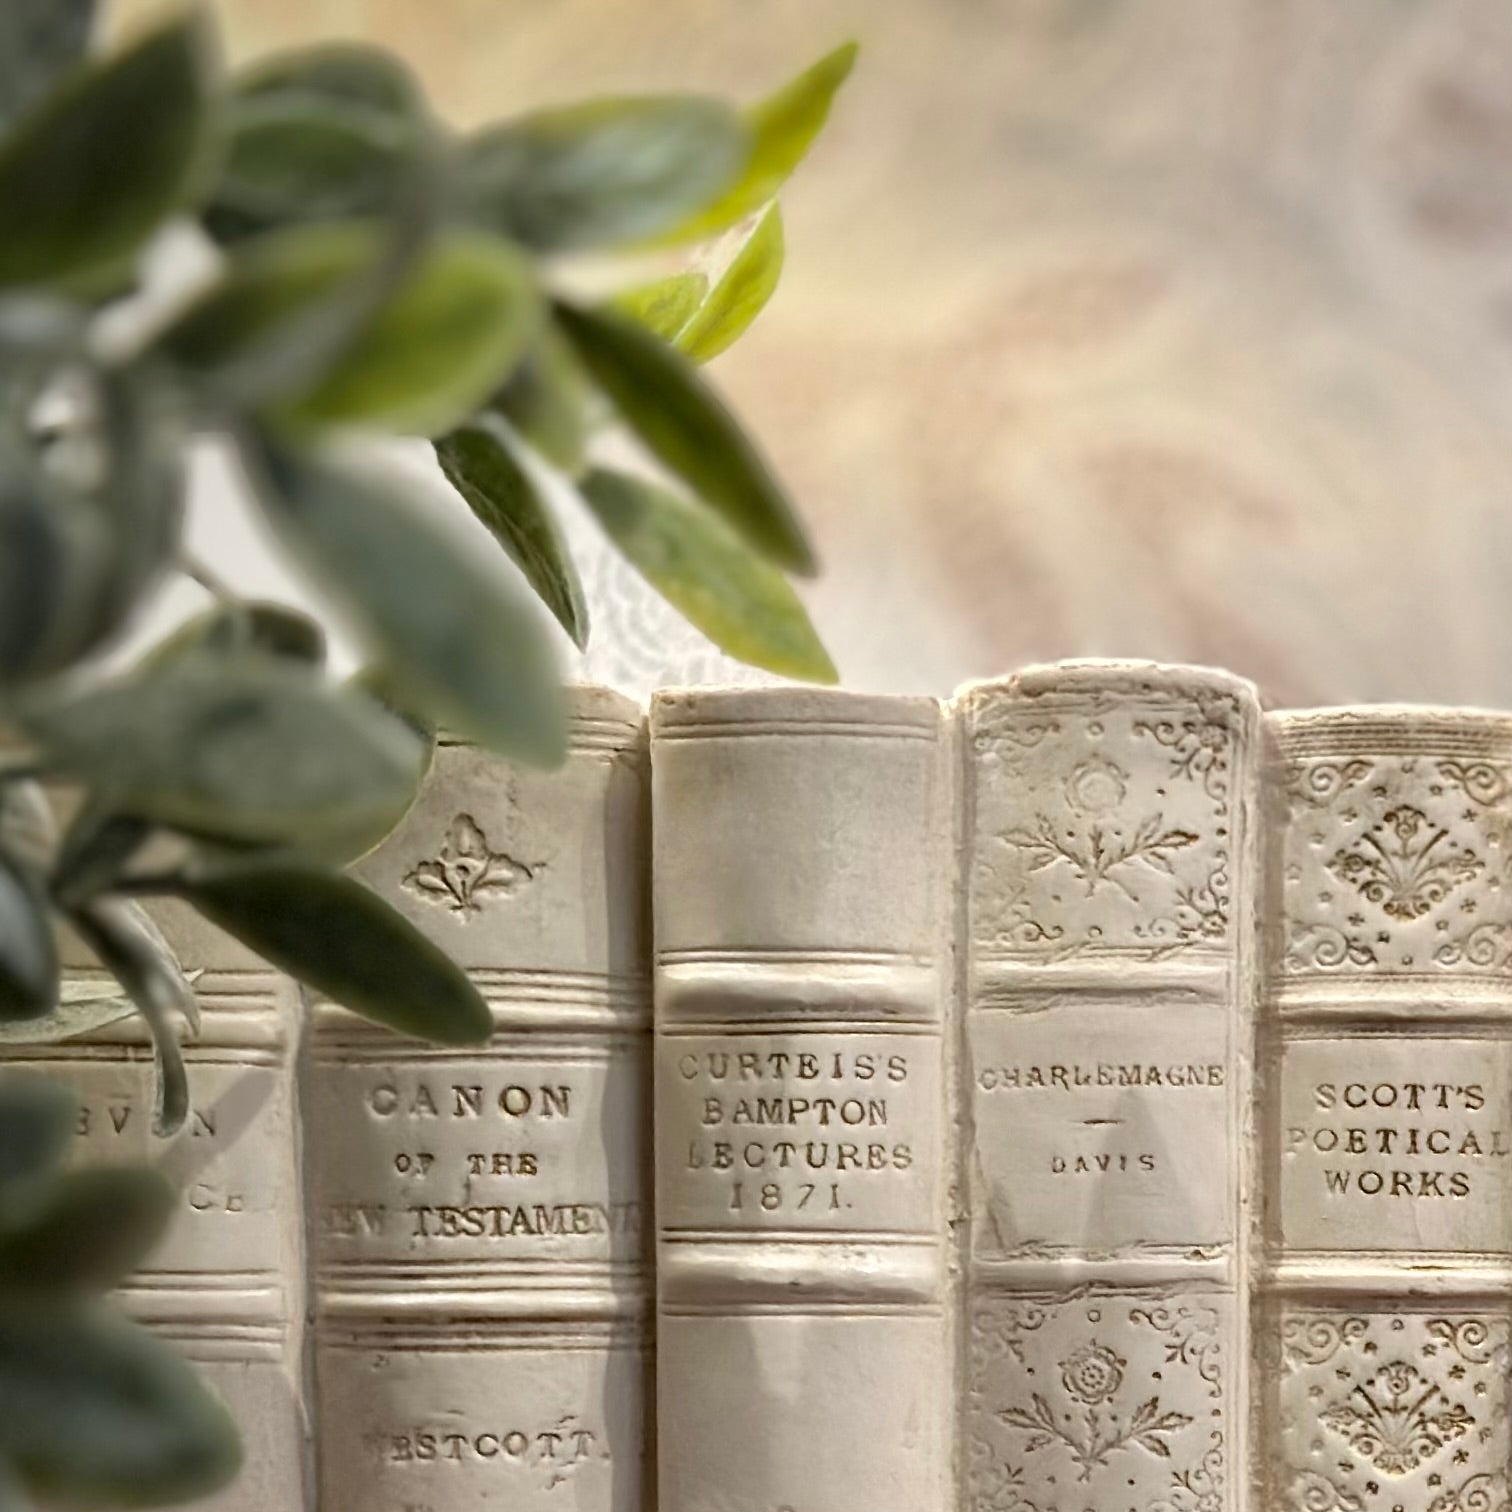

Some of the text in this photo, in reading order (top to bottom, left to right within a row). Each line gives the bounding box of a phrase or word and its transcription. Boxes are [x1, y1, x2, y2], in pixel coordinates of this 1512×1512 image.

[679, 1053, 908, 1081] CURTEIS'S
[978, 1065, 1224, 1090] CHARLEMAGNE
[370, 1085, 573, 1117] CANON
[1314, 1083, 1485, 1110] SCOTT'S
[702, 1098, 889, 1126] BAMPTON
[687, 1142, 912, 1170] LECTURES
[1286, 1128, 1510, 1156] POETICAL
[467, 1153, 538, 1176] THE
[1051, 1154, 1155, 1174] DAVIS
[731, 1183, 852, 1211] 1871.
[1325, 1170, 1471, 1197] WORKS
